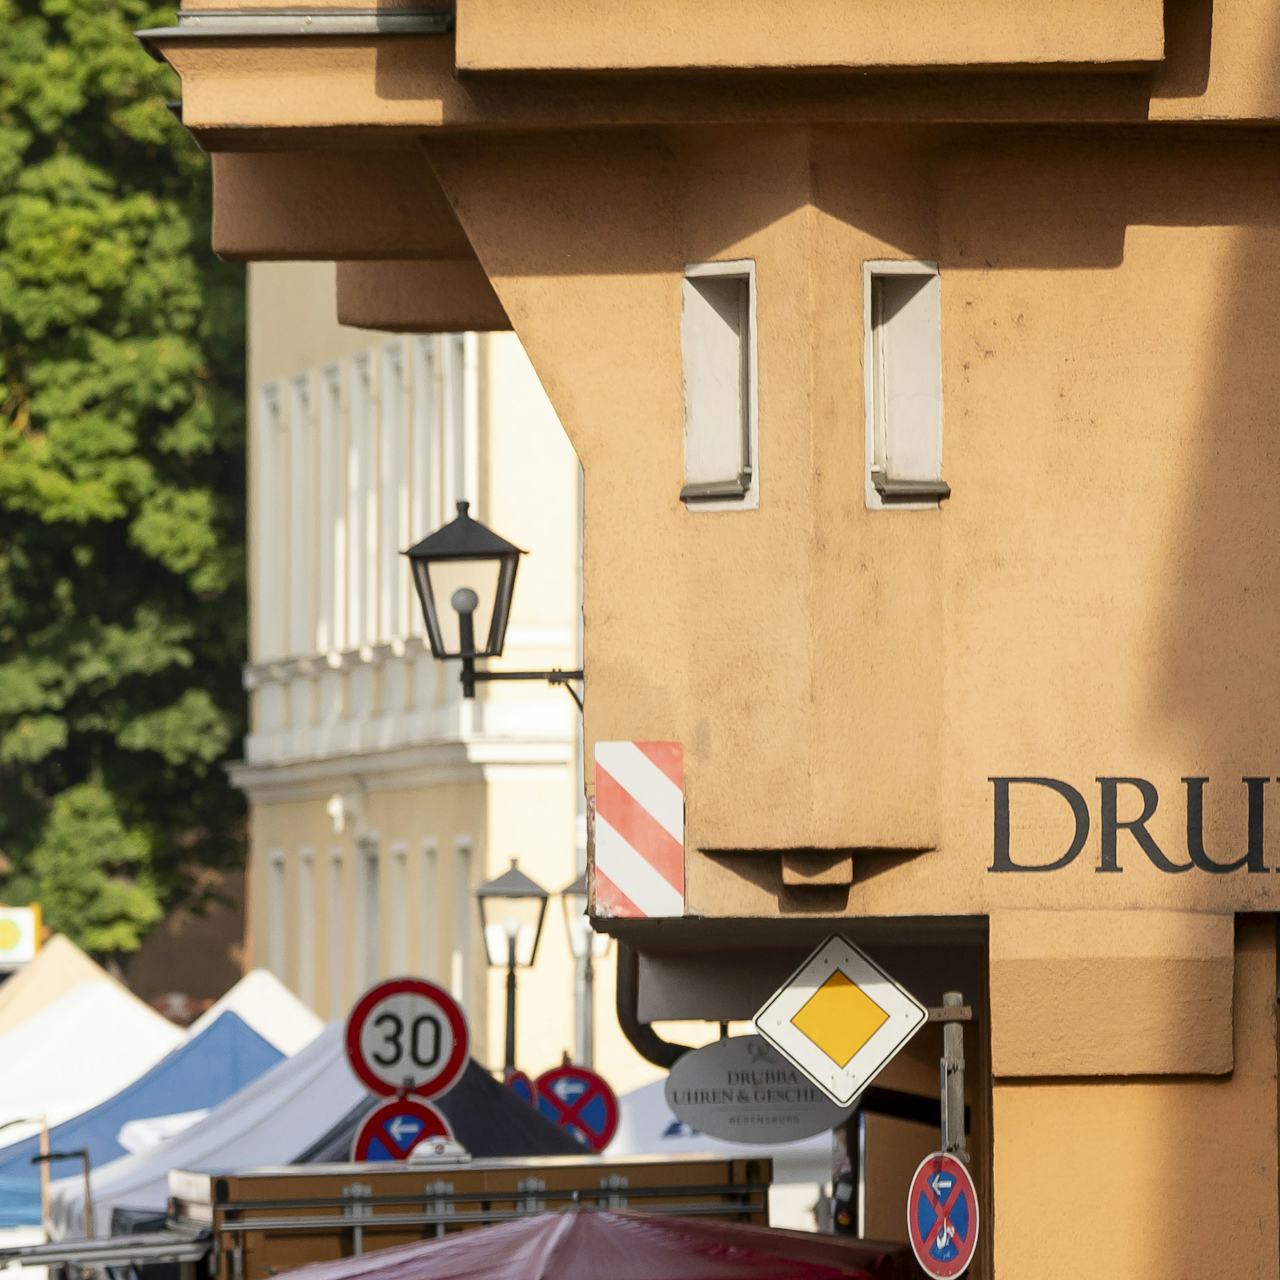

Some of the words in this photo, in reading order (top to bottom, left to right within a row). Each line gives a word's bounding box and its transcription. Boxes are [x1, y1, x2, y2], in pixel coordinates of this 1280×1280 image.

[987, 777, 1280, 873] DRU
[372, 1011, 441, 1068] 30
[673, 1088, 735, 1105] UHREN
[738, 1090, 750, 1104] &
